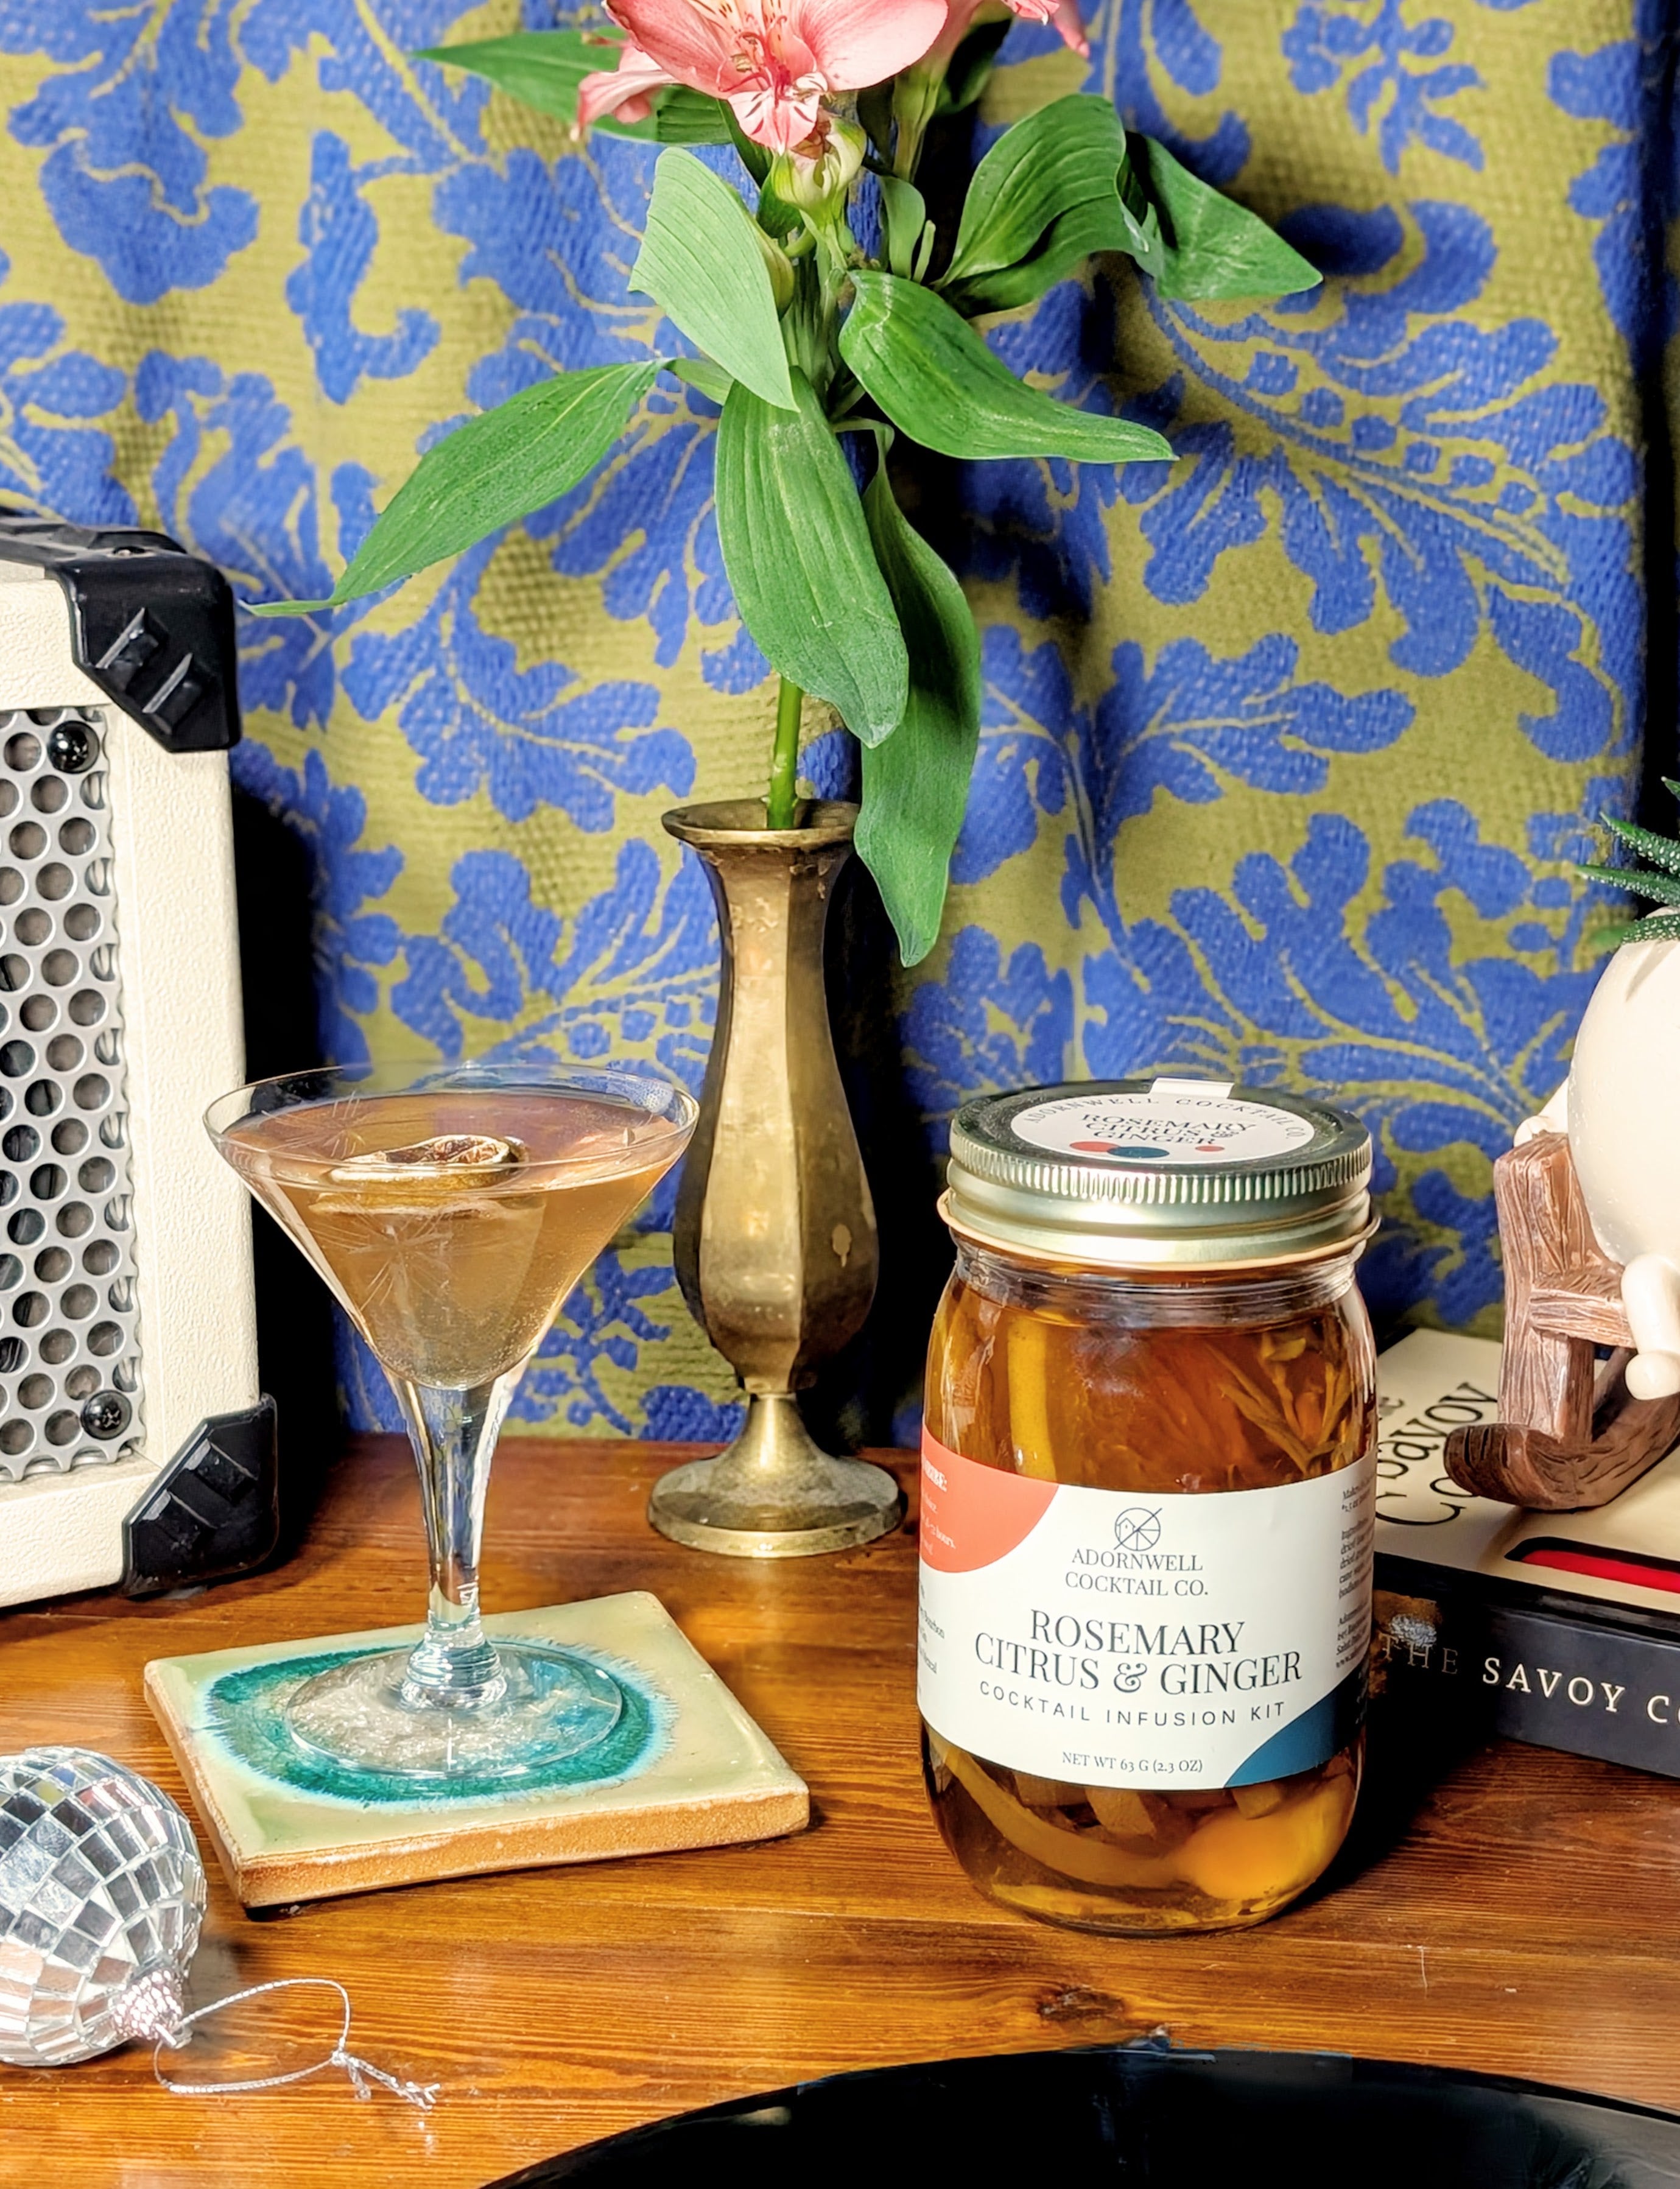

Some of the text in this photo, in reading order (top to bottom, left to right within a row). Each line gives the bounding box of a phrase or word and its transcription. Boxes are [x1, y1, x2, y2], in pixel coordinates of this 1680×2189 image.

[1024, 1098, 1159, 1123] ADORNWELL
[1176, 1098, 1294, 1125] COCKTAIL
[1082, 1114, 1257, 1131] ROSEMARY
[1086, 1122, 1201, 1136] CITRUS
[1094, 1131, 1215, 1144] GINGER
[1072, 1548, 1203, 1571] ADORNWELL
[1065, 1571, 1208, 1596] COCKTAIL CO.
[1030, 1609, 1245, 1656] ROSEMARY
[975, 1632, 1302, 1695] CITRUS & GINGER
[1378, 1632, 1458, 1674] THE
[1482, 1657, 1626, 1713] SAVOY
[1647, 1695, 1680, 1726] C
[980, 1681, 1285, 1726] COCKTAIL INFUSION KIT
[1063, 1751, 1203, 1774] NET WT 63 G (2.3 OZ)
